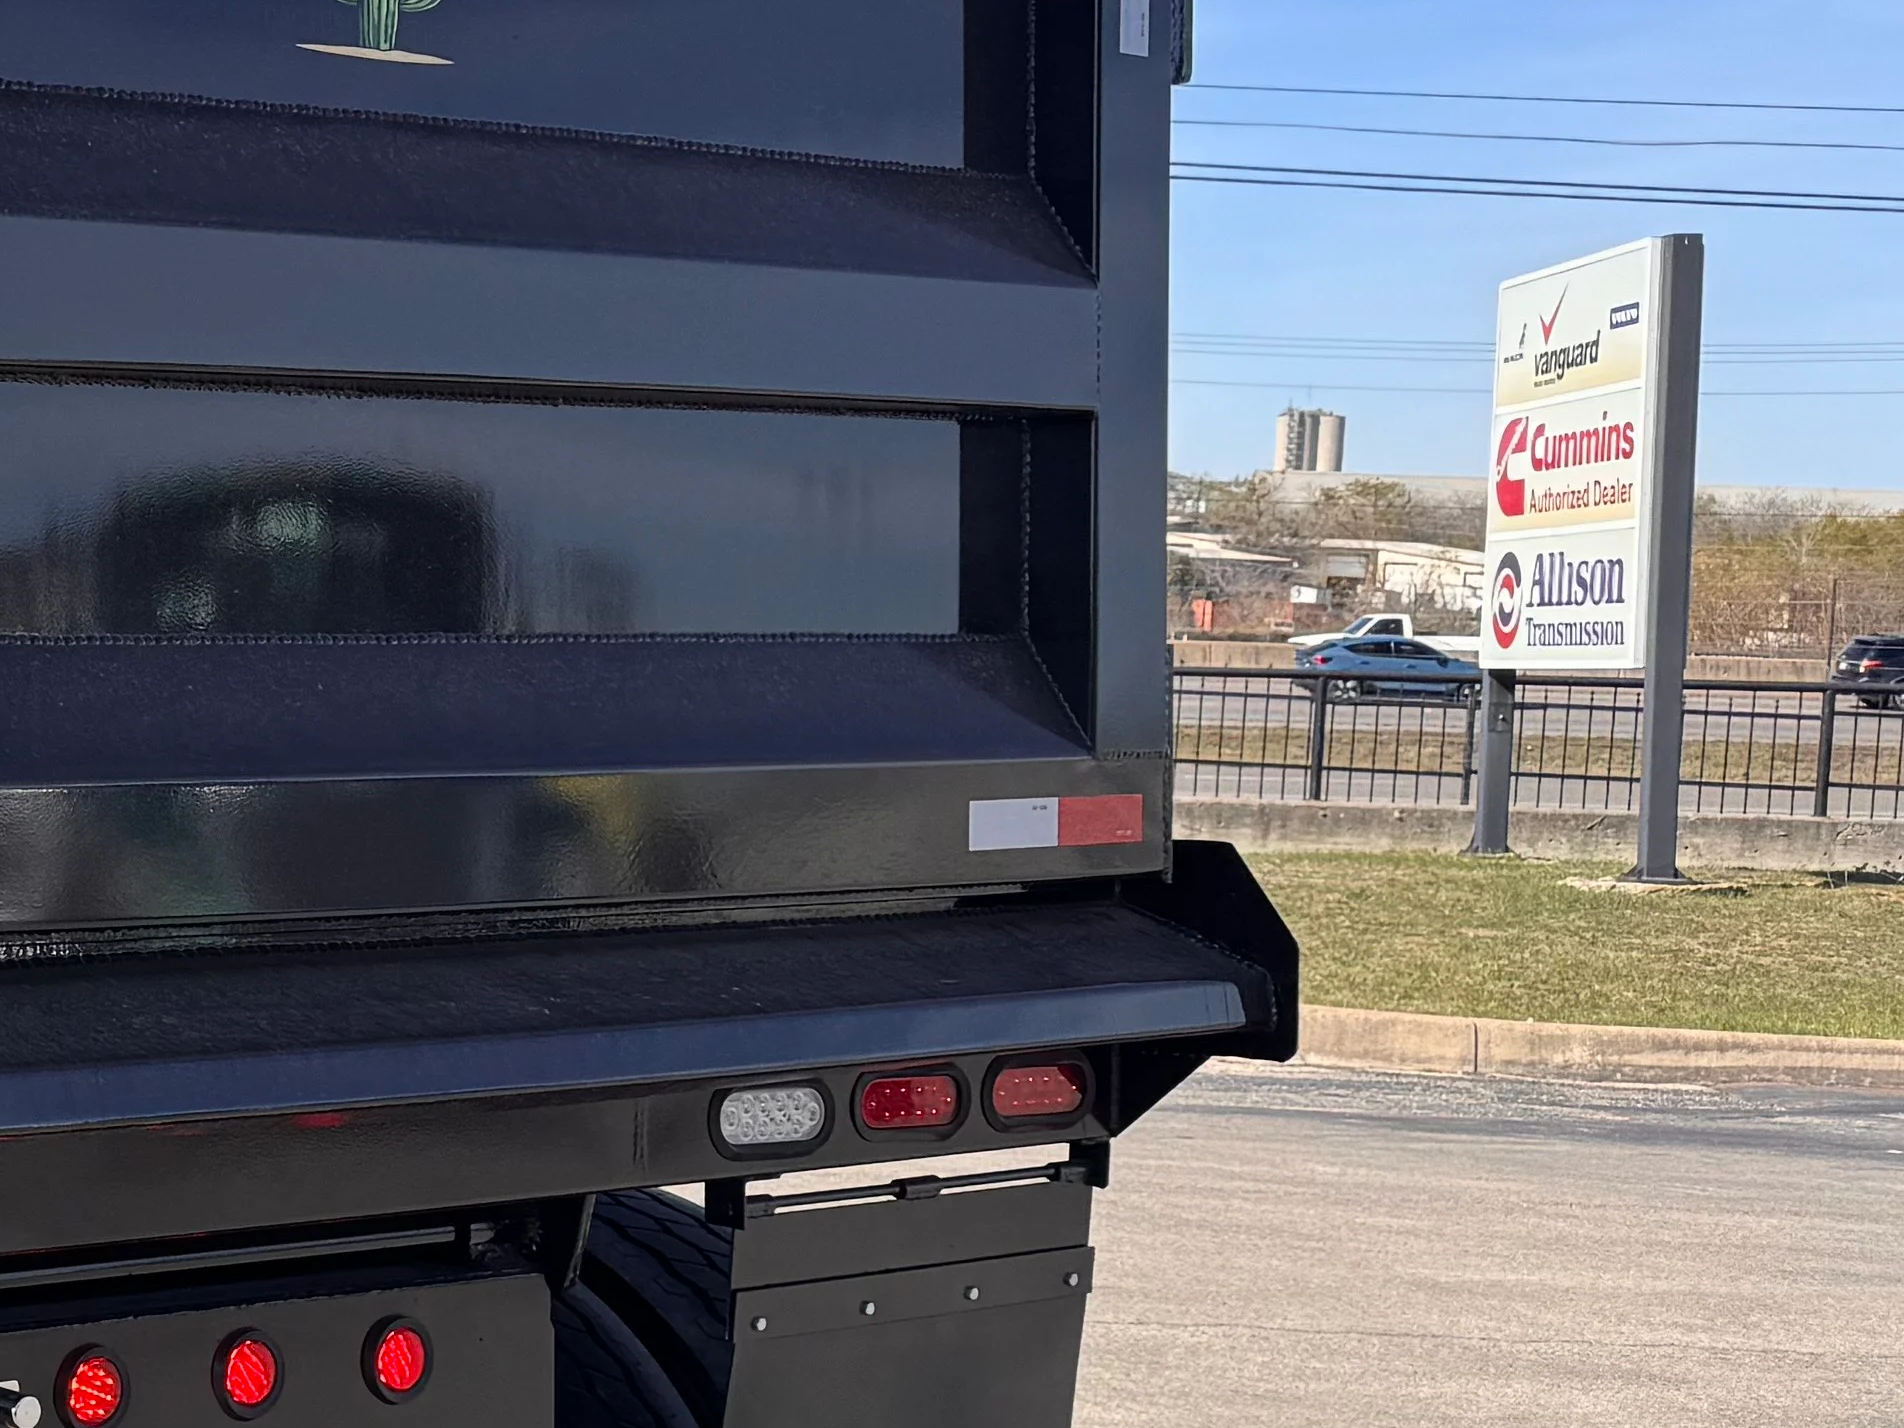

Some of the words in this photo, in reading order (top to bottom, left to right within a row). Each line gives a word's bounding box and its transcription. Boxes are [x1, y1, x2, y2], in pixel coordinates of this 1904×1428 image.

[1534, 329, 1601, 381] vanguard
[1530, 410, 1635, 472] Cummins
[1529, 482, 1590, 514] Authorized
[1593, 477, 1634, 507] Dealer
[1525, 551, 1625, 608] Allison
[1525, 617, 1625, 647] Transmission
